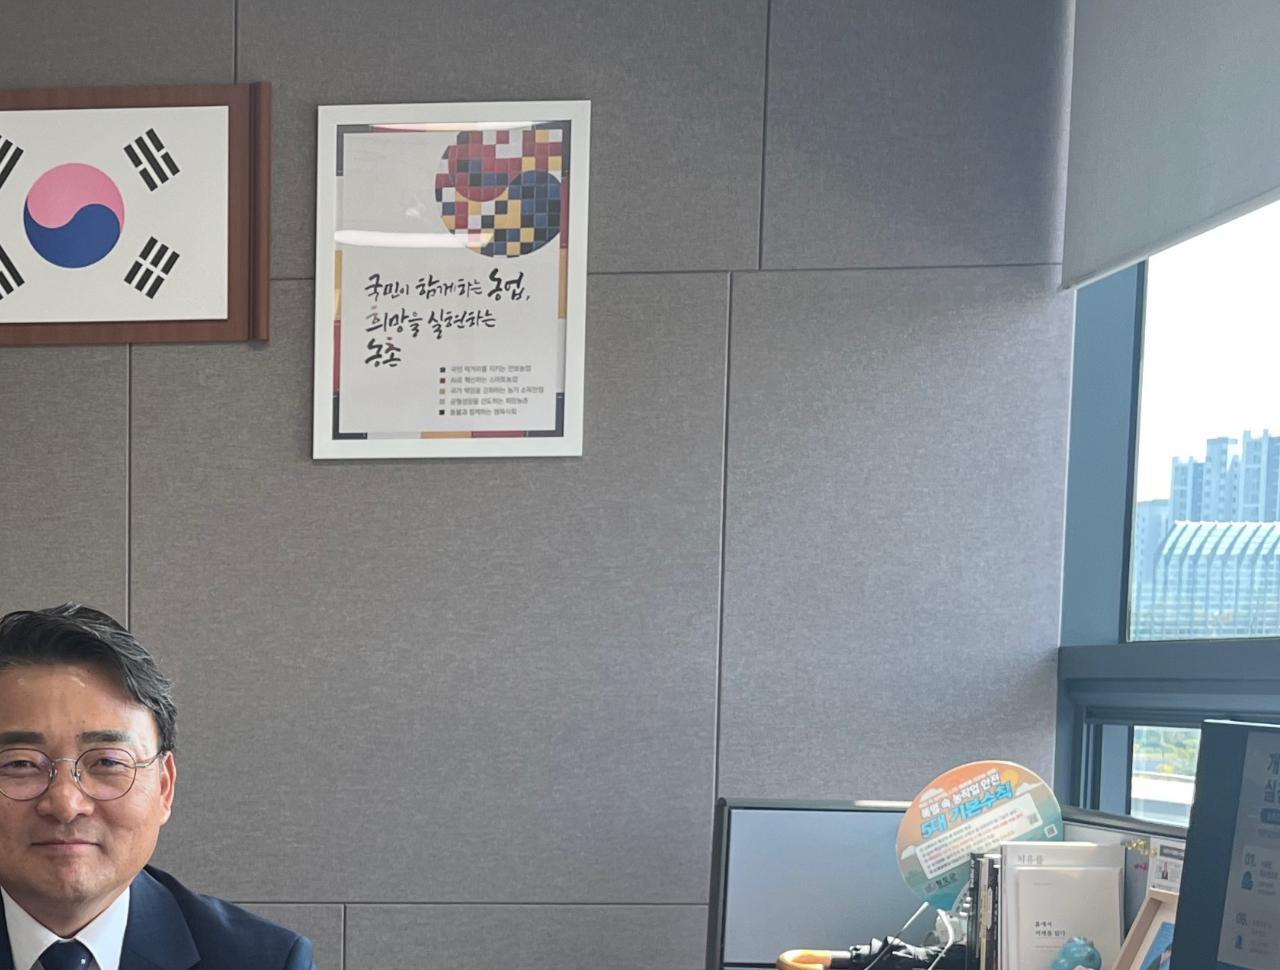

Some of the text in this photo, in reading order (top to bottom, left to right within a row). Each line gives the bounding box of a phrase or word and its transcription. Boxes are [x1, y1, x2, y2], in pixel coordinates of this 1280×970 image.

[364, 268, 531, 301] 국민이 함께하는 농업,
[365, 306, 497, 340] 희망을 실현하는
[365, 336, 402, 368] 농촌
[952, 784, 980, 806] 농작업
[981, 772, 1001, 790] 안전
[921, 815, 948, 839] 5대
[952, 782, 1013, 821] 기본수칙
